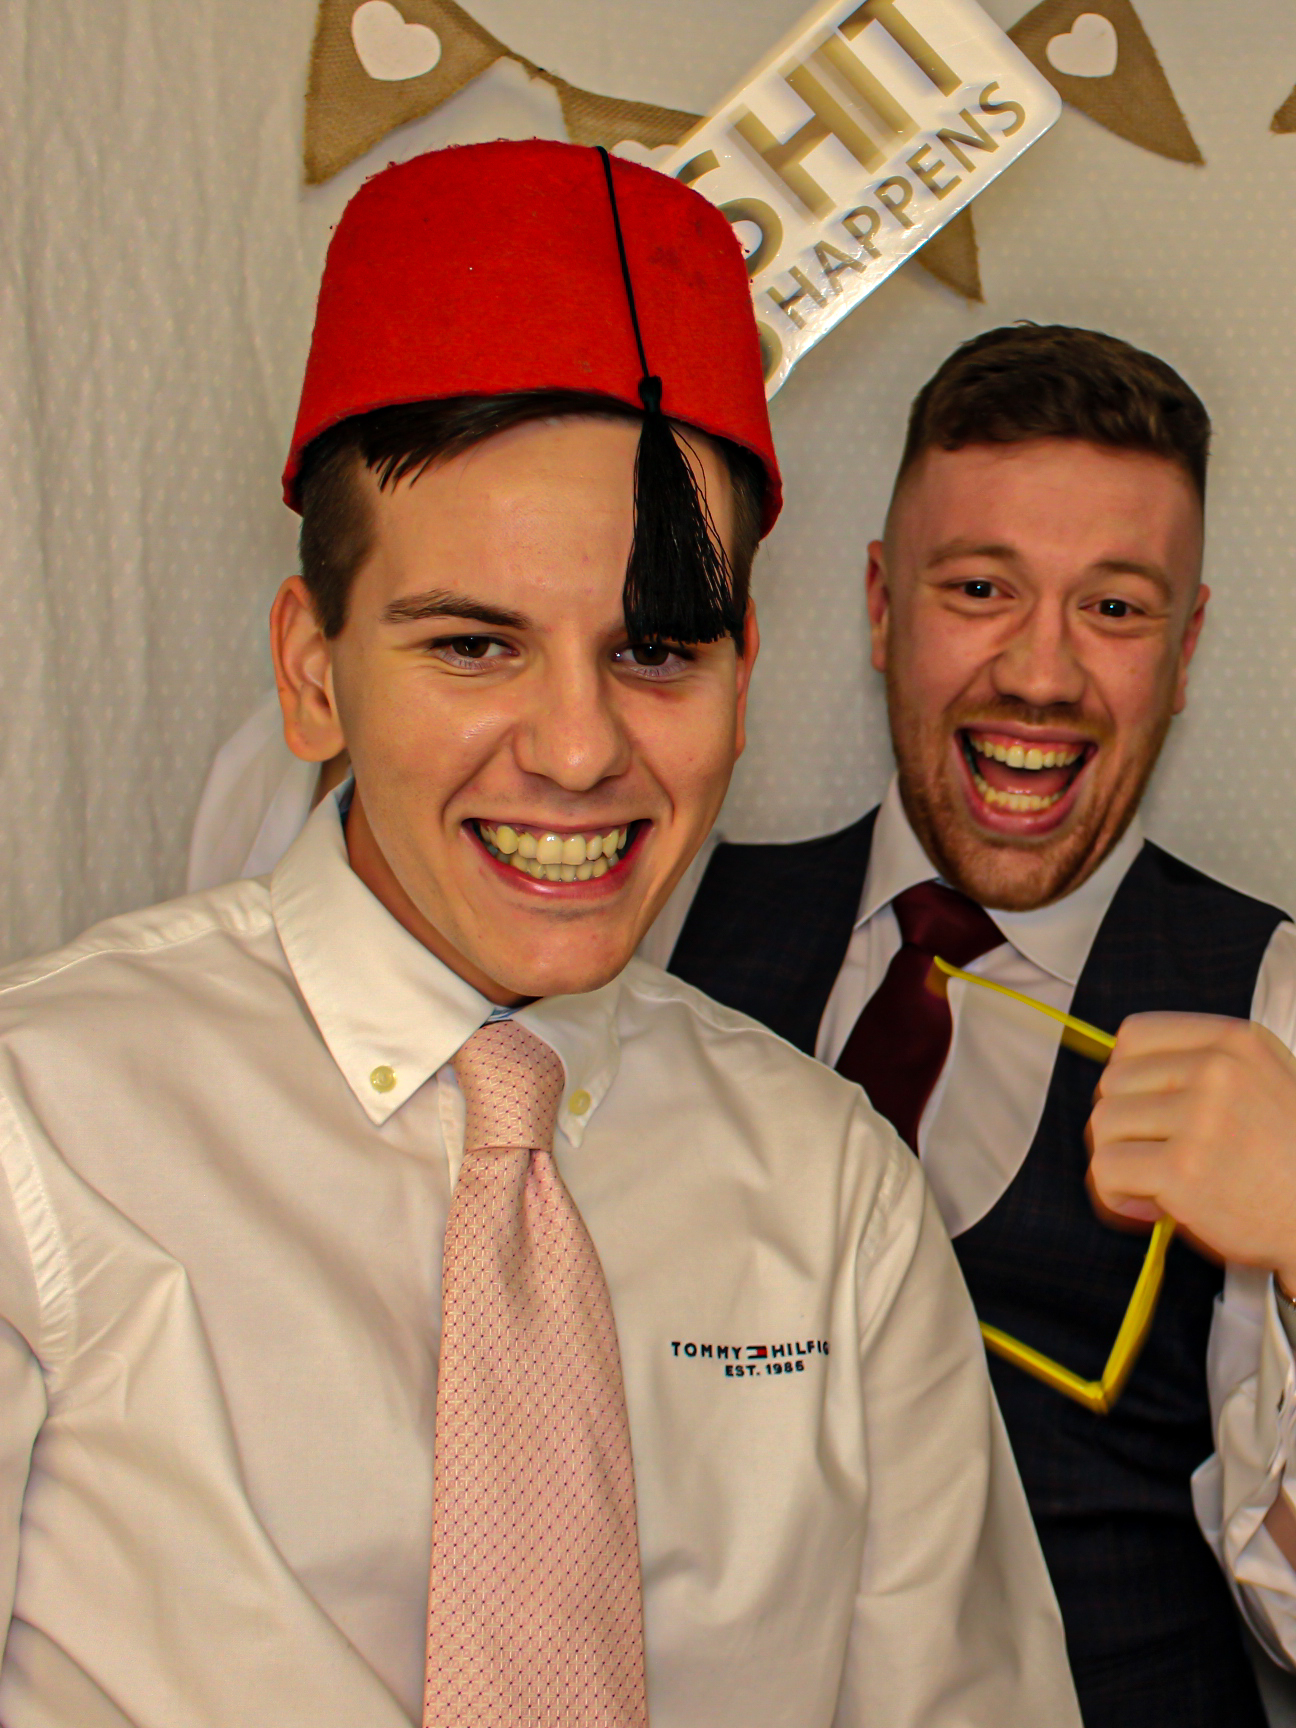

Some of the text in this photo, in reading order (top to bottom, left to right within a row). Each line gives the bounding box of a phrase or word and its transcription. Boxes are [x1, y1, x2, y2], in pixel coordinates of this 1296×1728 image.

[766, 81, 1026, 330] HAPPENS
[671, 1341, 742, 1360] TOMMY
[725, 1364, 760, 1377] EST.
